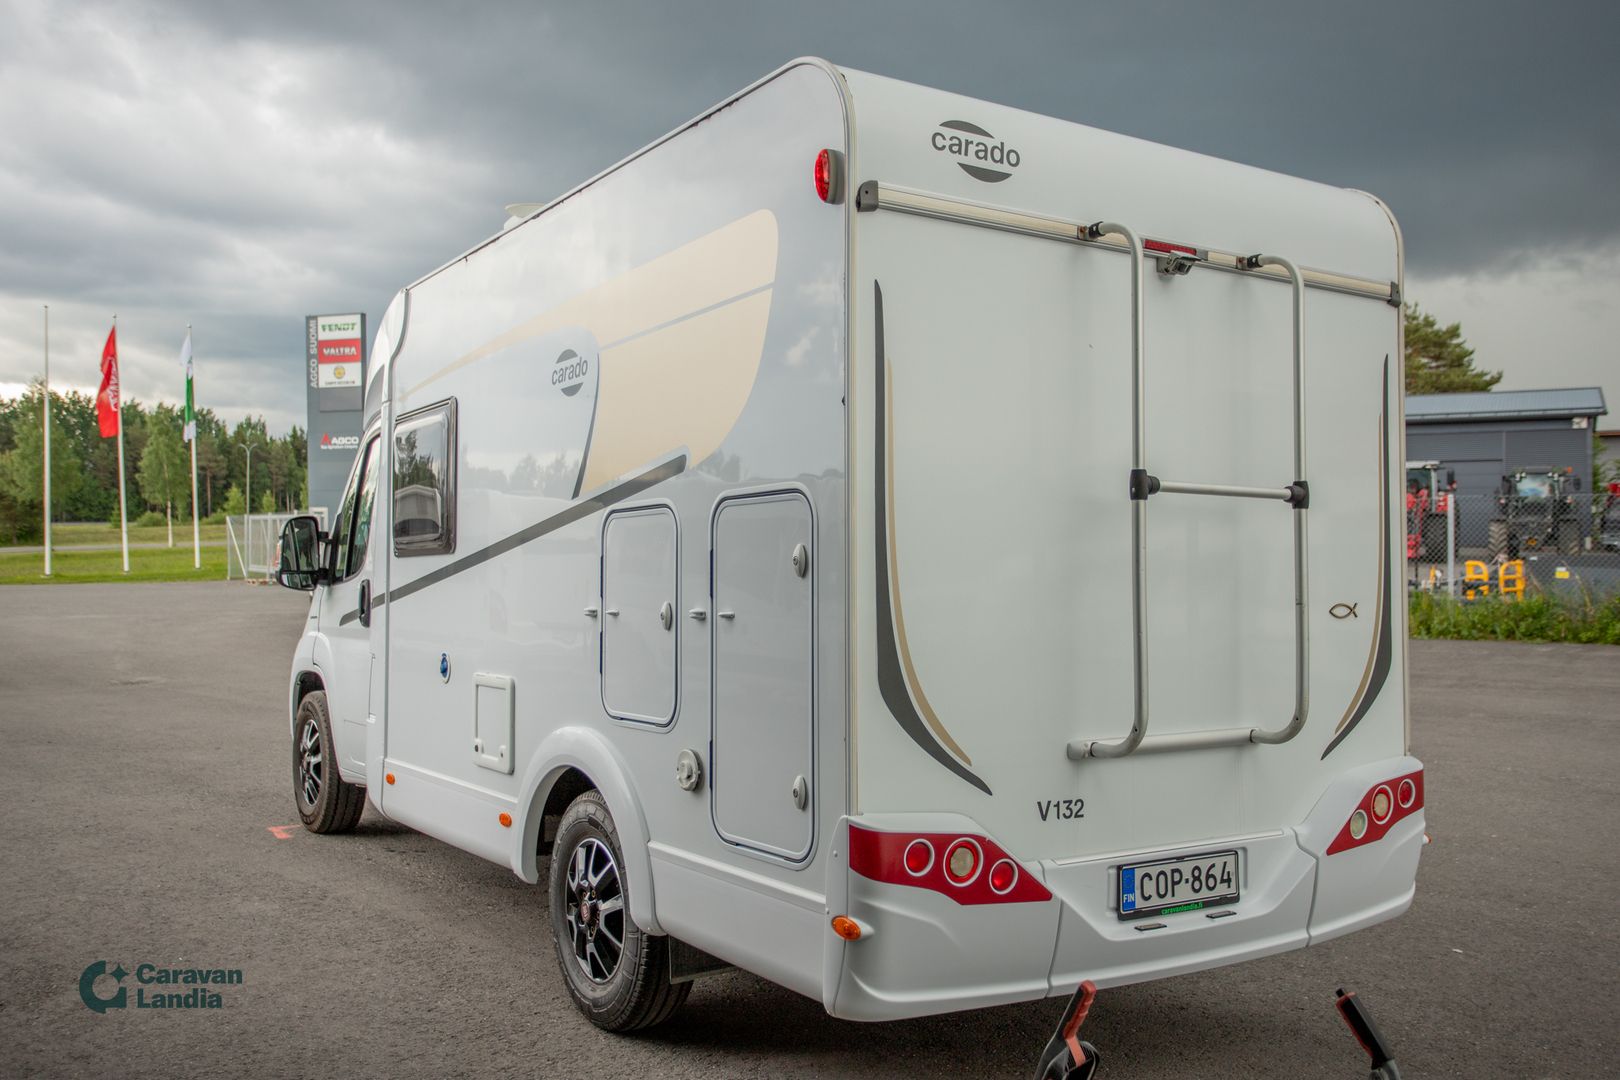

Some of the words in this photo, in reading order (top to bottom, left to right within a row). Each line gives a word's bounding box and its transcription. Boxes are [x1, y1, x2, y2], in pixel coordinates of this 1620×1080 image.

[931, 132, 1021, 168] carado
[309, 319, 317, 354] SUOMI
[321, 322, 357, 332] FENDT
[322, 346, 357, 356] VALTRA
[310, 358, 318, 389] AGCO
[551, 356, 588, 385] carado
[331, 436, 359, 445] AGCO
[1037, 798, 1084, 821] V132
[1140, 861, 1232, 901] COP-864
[1123, 893, 1135, 903] FIN
[1161, 902, 1204, 916] caravanlandia.fi
